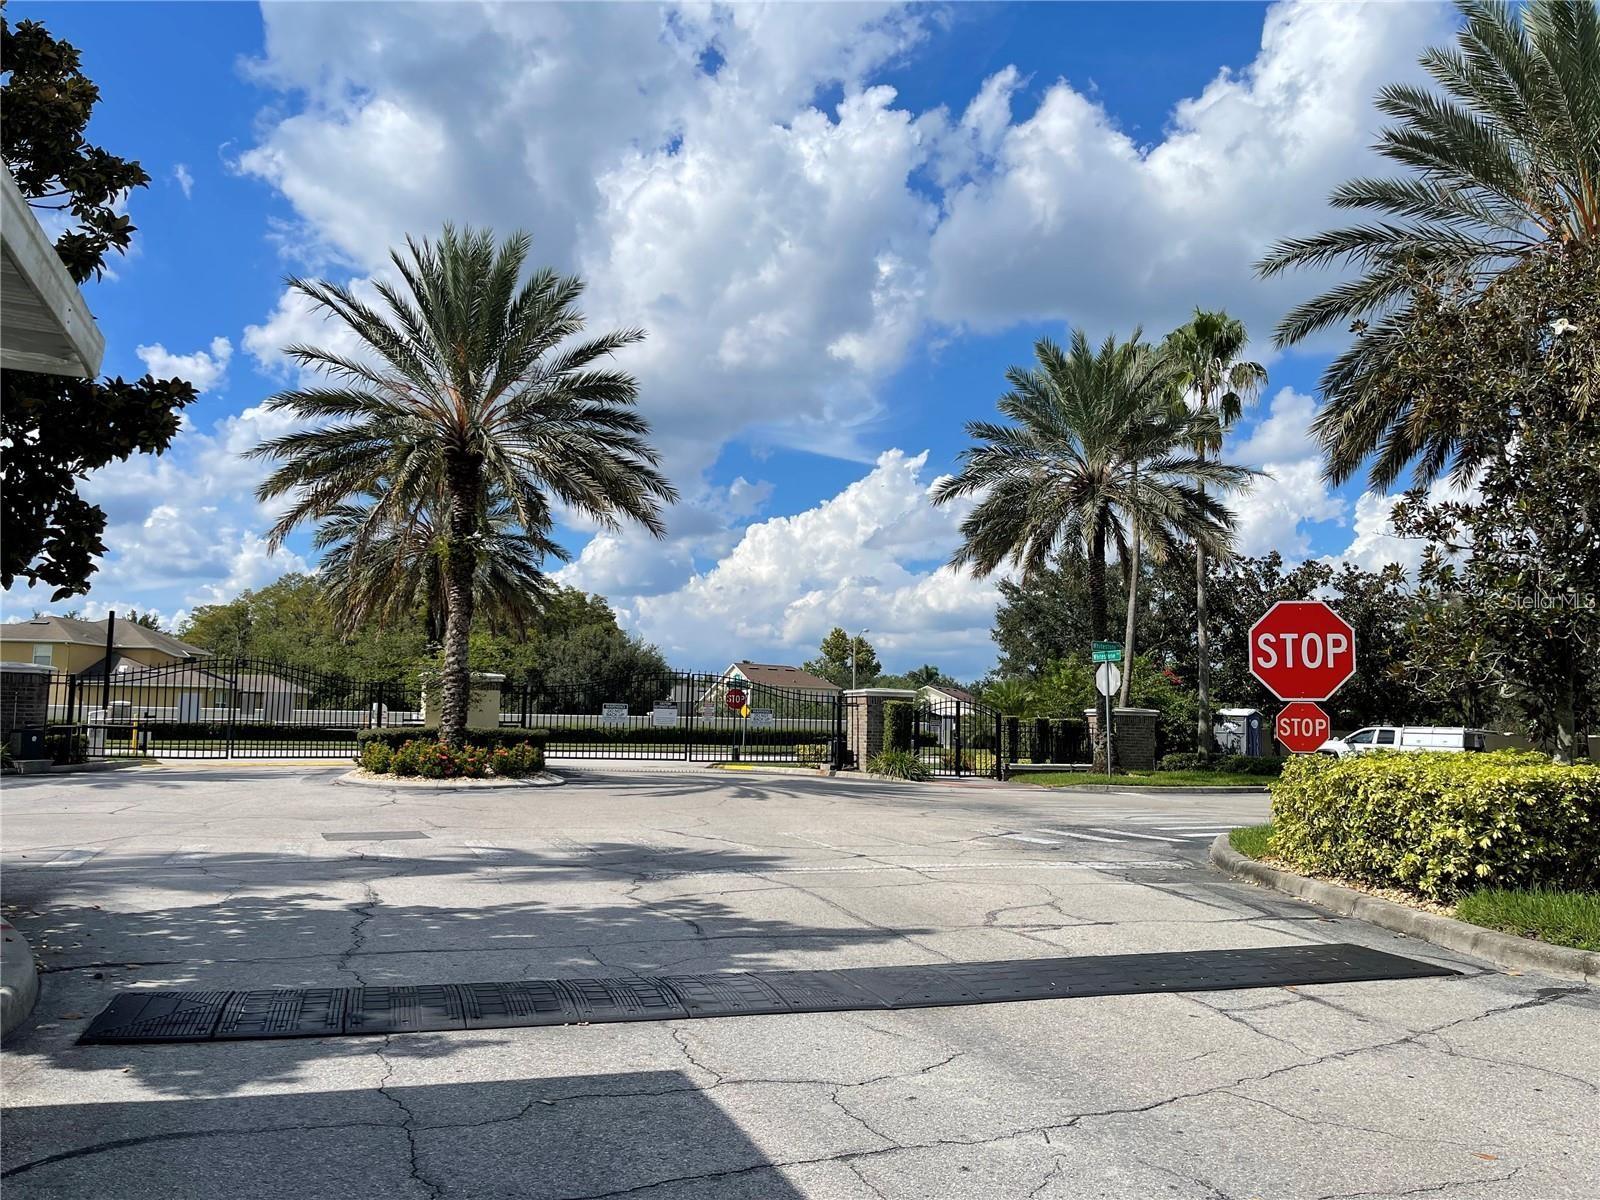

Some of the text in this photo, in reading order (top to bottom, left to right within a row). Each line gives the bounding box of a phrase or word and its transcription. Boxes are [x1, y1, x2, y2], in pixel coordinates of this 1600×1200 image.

[1257, 632, 1348, 669] STOP
[727, 694, 745, 703] STOP
[1279, 717, 1327, 737] STOP
